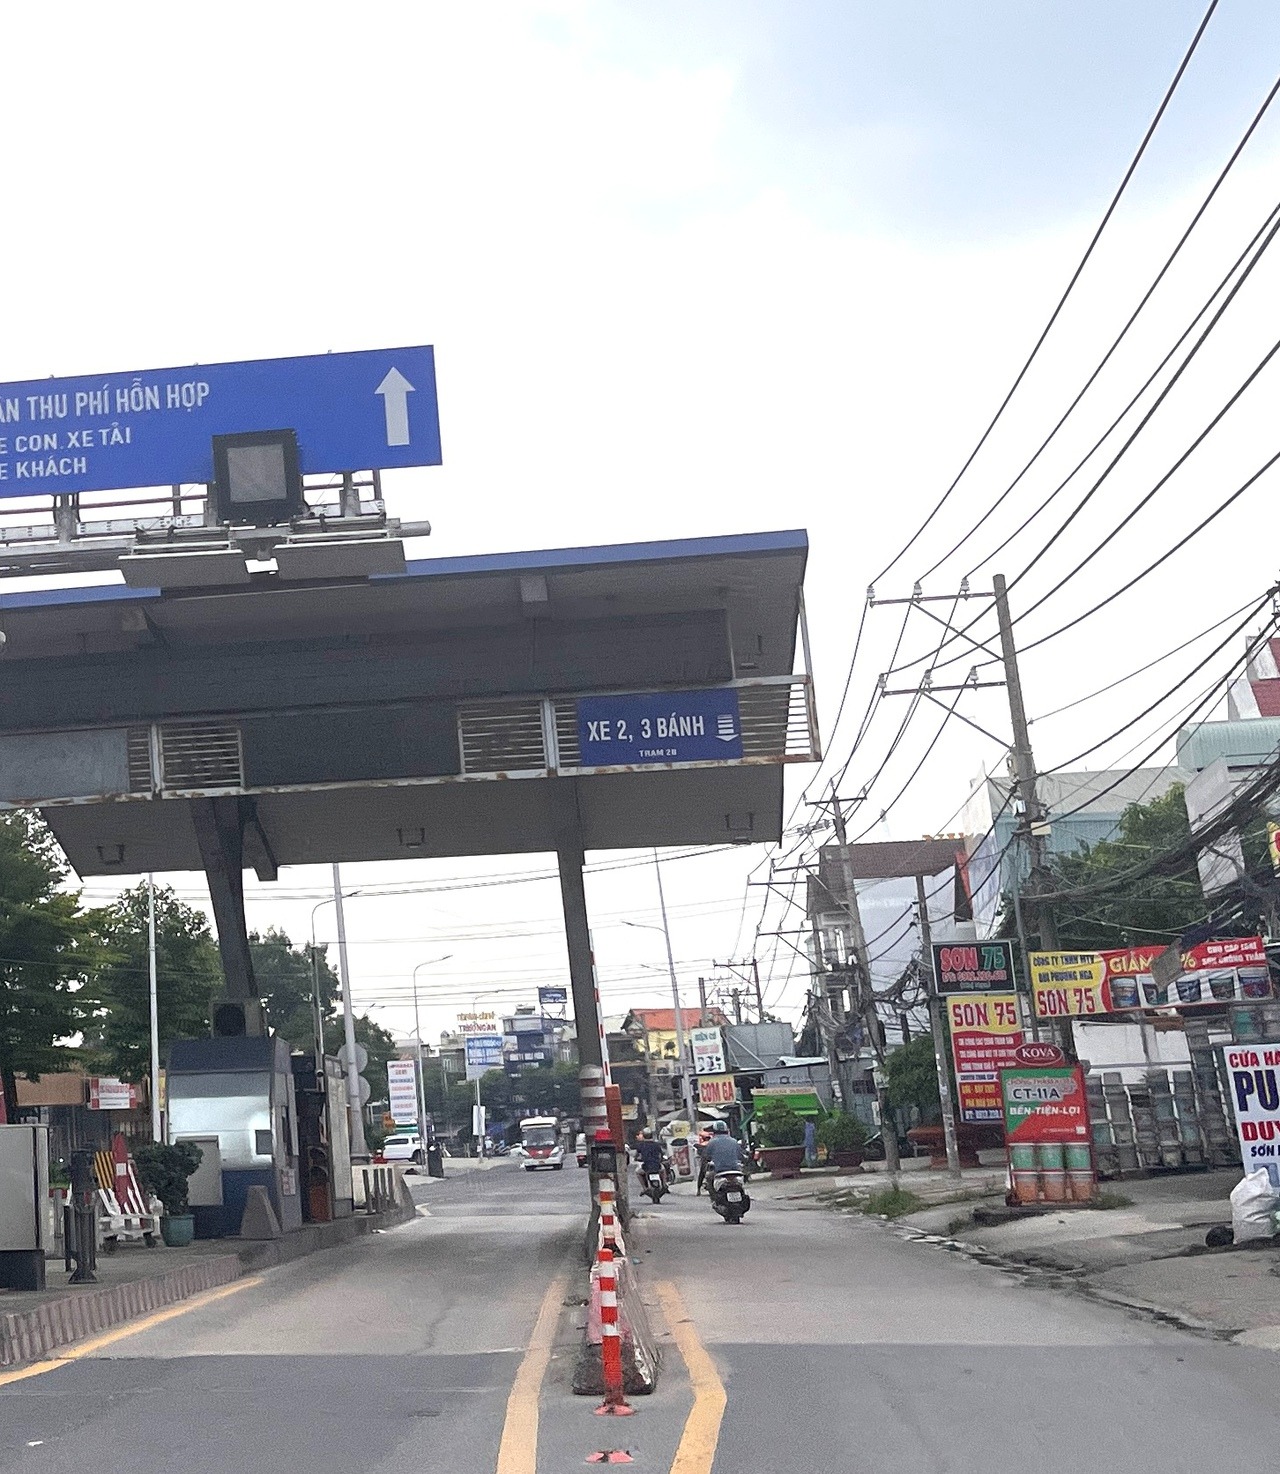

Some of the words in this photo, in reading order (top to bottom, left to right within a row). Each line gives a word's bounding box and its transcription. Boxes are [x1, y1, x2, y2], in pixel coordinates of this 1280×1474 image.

[27, 394, 67, 420] THU
[76, 384, 109, 416] PHÍ
[116, 378, 159, 412] HỖN
[166, 382, 210, 412] HỢP
[67, 430, 94, 449] XE
[98, 422, 131, 446] TẢI
[16, 455, 87, 479] KHÁCH
[588, 721, 611, 742] XE
[617, 720, 633, 742] 2,
[641, 718, 651, 738] 3
[657, 712, 705, 738] BÁNH
[940, 947, 979, 972] SƠN
[981, 946, 1005, 970] 75
[1033, 956, 1049, 966] CÔNG
[1051, 956, 1059, 966] TY
[1060, 955, 1078, 965] TNHH
[1073, 988, 1096, 1014] 75
[994, 1002, 1017, 1026] 75
[1021, 1048, 1055, 1058] KOVA
[1229, 1050, 1260, 1068] CỬA
[1013, 1087, 1060, 1099] CT-11A
[1251, 1143, 1275, 1157] SƠN
